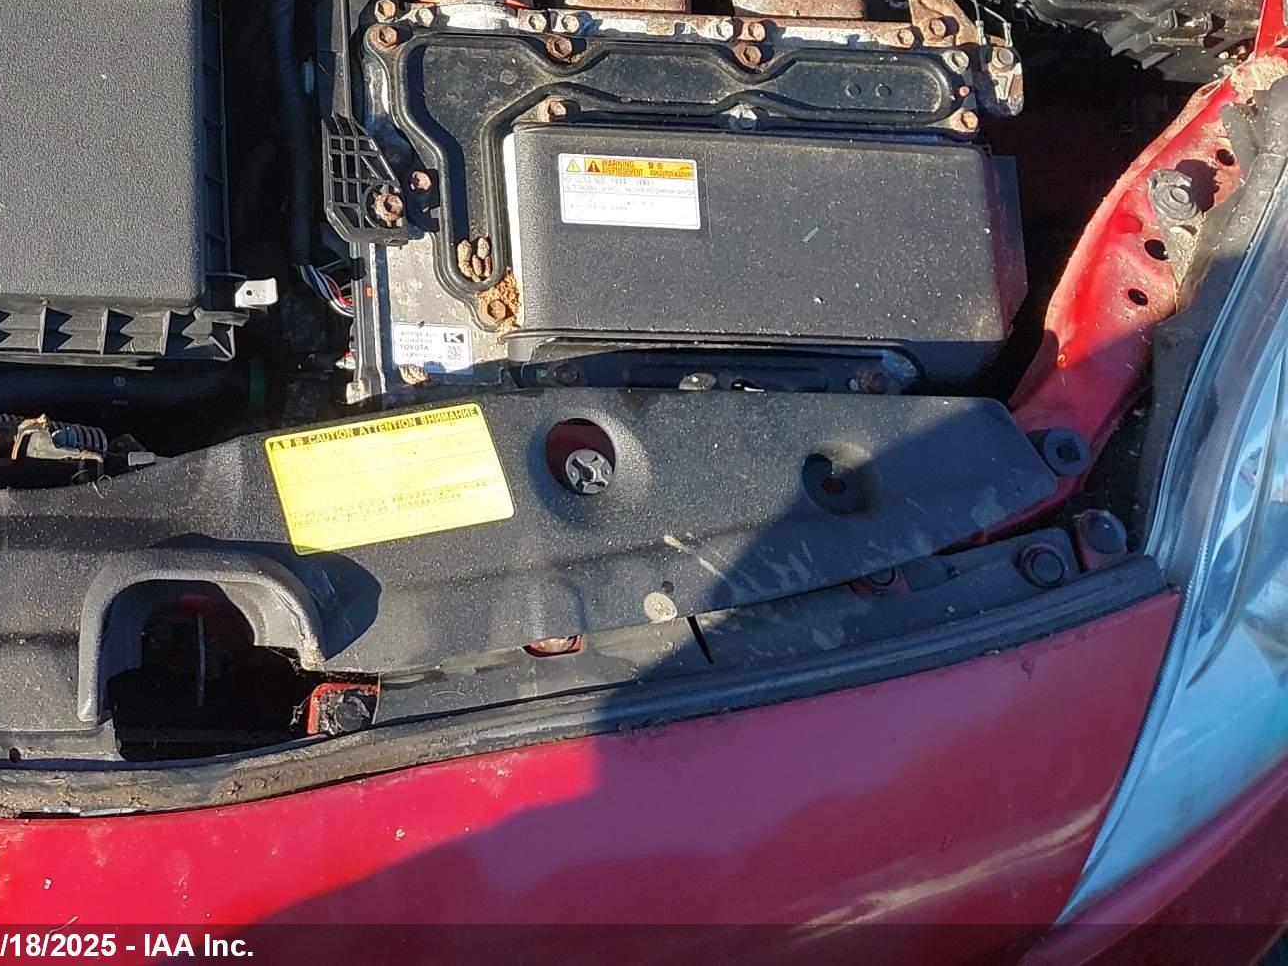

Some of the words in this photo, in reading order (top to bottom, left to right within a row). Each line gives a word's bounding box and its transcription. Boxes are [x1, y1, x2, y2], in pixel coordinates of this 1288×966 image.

[601, 159, 635, 170] WARNING
[308, 428, 354, 446] CAUTION
[359, 417, 417, 436] ATTENTION
